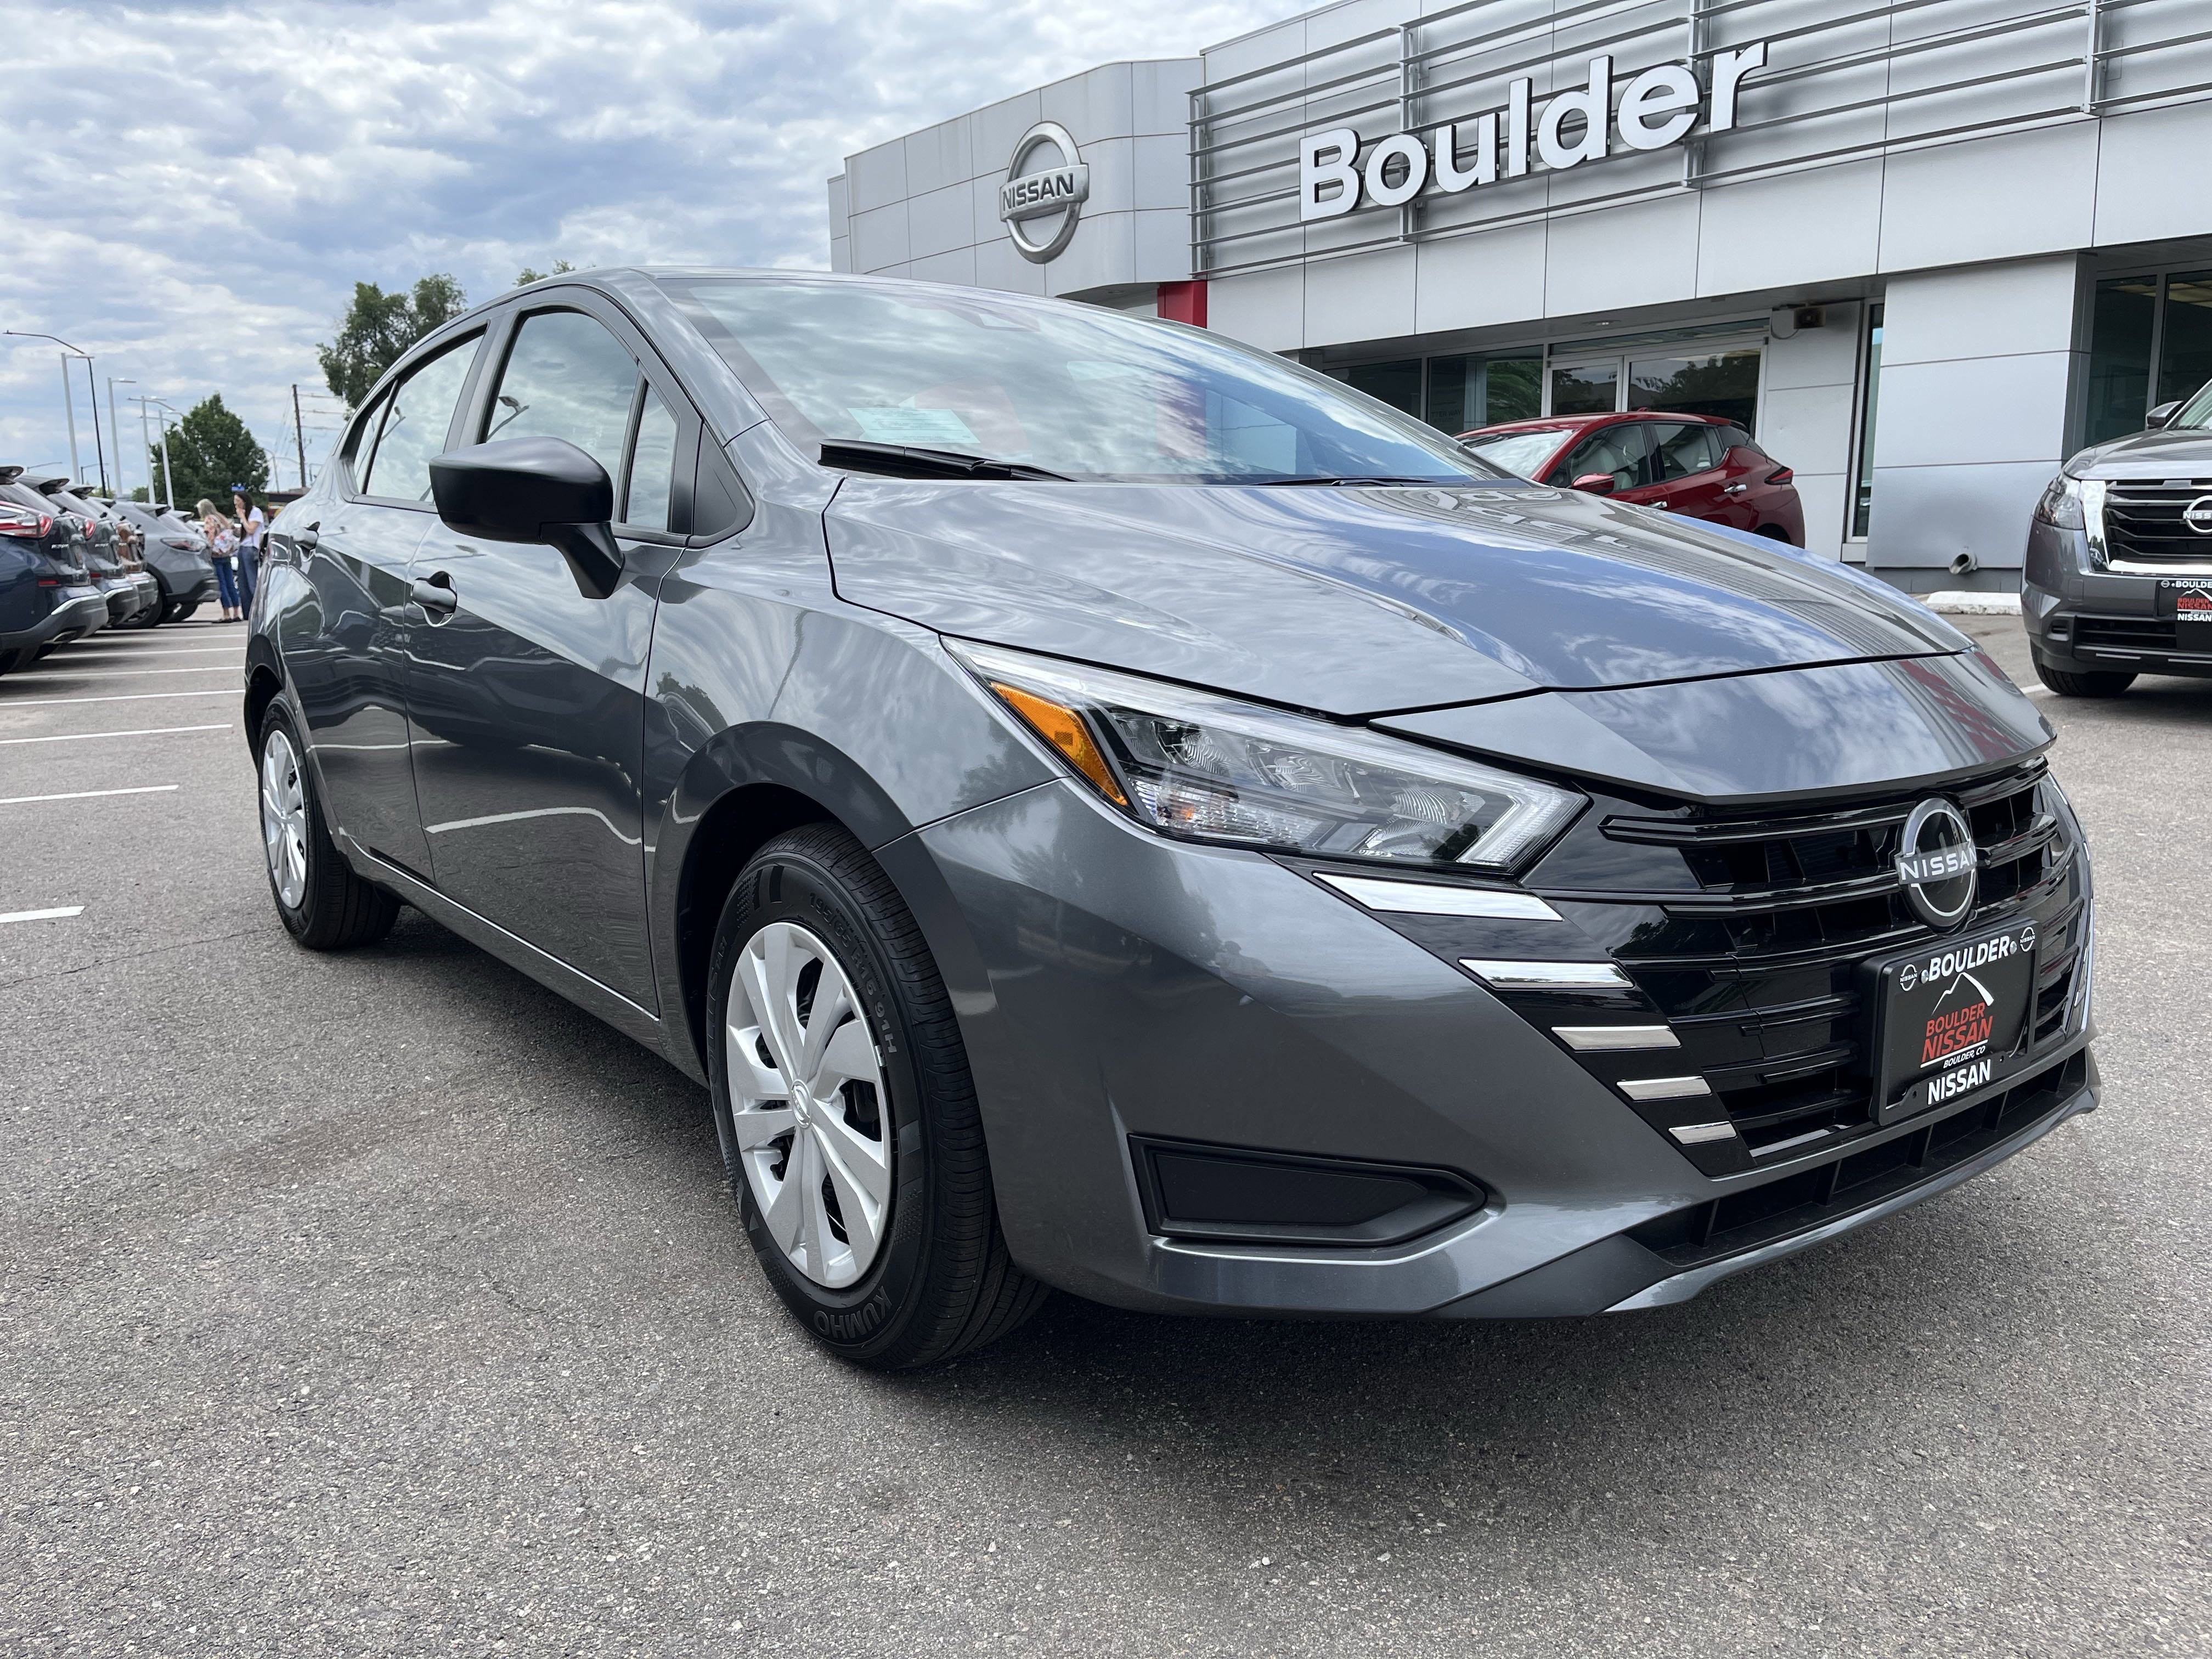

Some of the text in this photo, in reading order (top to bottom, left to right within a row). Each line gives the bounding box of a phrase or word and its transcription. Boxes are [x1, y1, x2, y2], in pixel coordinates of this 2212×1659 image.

[1300, 41, 1767, 222] Boulder
[1002, 172, 1074, 211] NISSAN
[2177, 613, 2212, 622] NISSAN
[1899, 845, 1977, 881] NISSAN
[1928, 935, 2010, 982] BOULDER
[2019, 935, 2036, 944] NISSAN
[1900, 973, 1917, 983] NISSAN
[874, 1001, 897, 1053] 91H
[1922, 1015, 1993, 1063] NISSAN
[1926, 1002, 1985, 1037] BOULDER
[1943, 1046, 1986, 1069] BOULDER, CO
[1927, 1059, 1991, 1105] NISSAN
[814, 1285, 892, 1339] KUMHO
